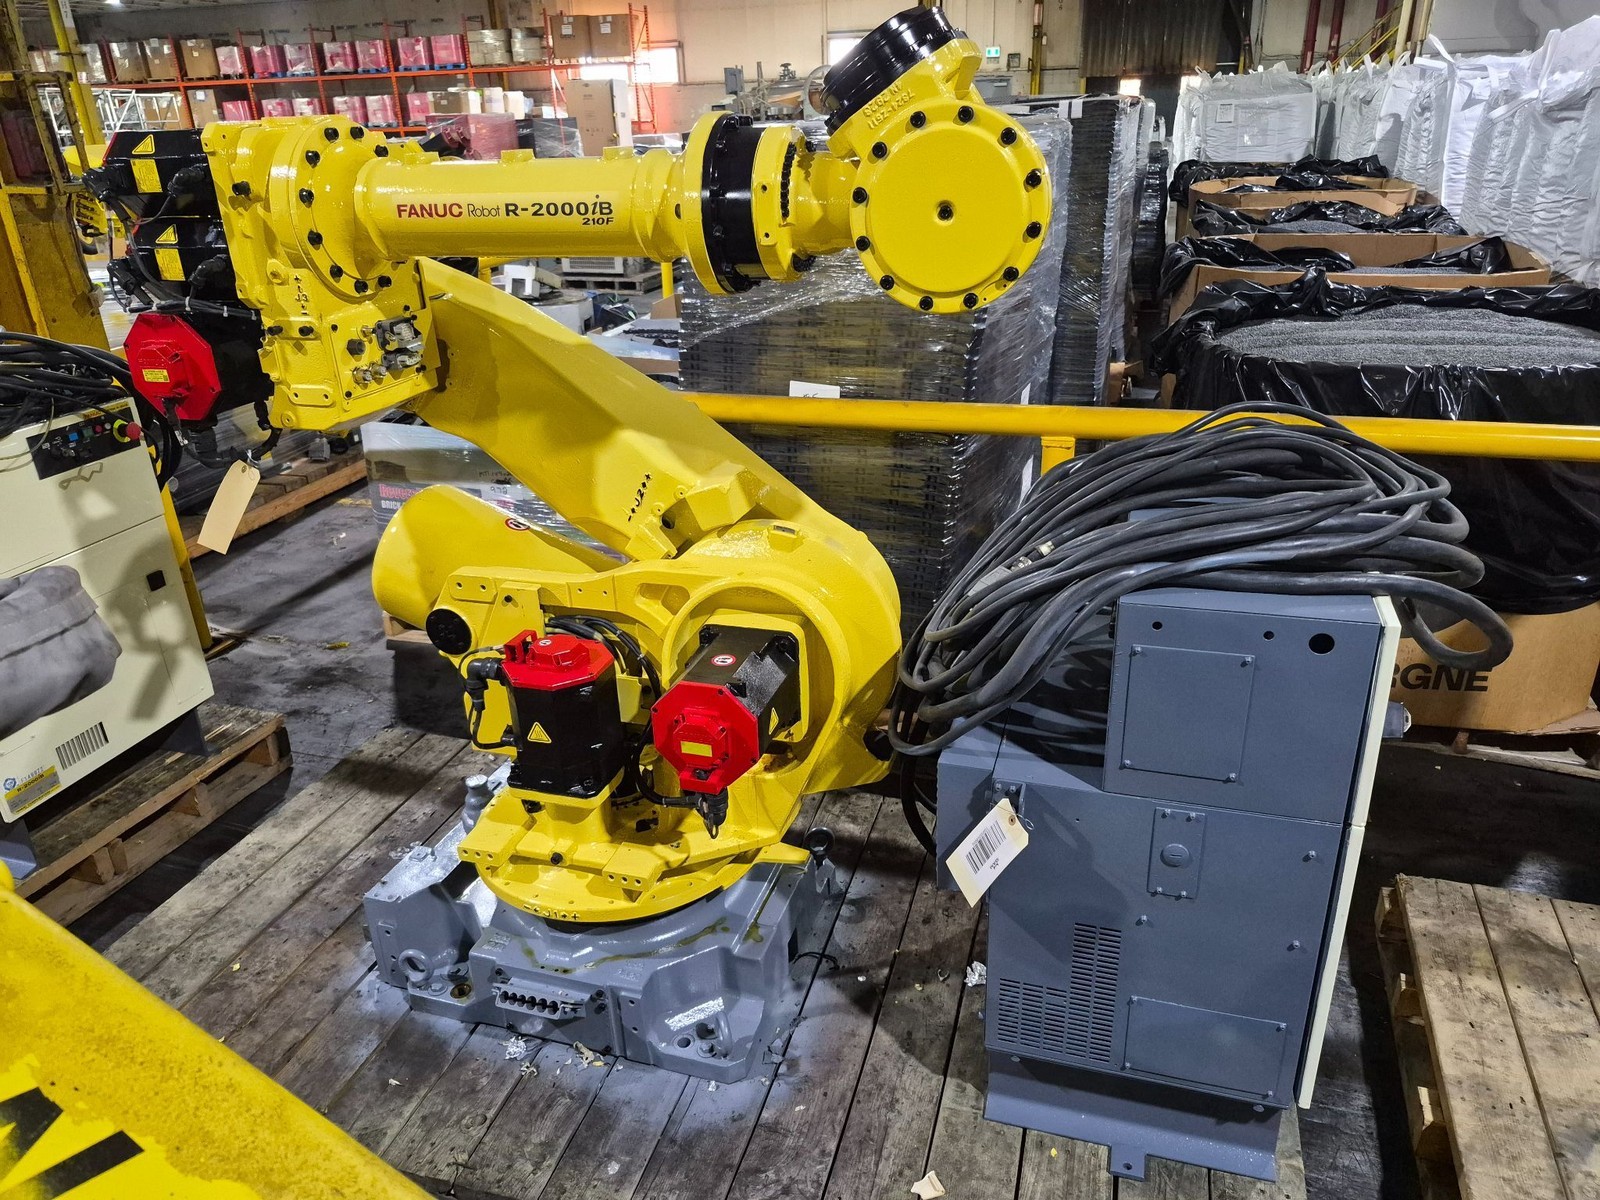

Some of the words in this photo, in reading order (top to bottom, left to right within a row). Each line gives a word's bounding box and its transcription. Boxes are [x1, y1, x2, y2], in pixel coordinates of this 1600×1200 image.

[397, 203, 464, 219] FANUC
[467, 203, 501, 218] Robot
[505, 194, 614, 217] R-2000iB
[582, 217, 615, 226] 210F
